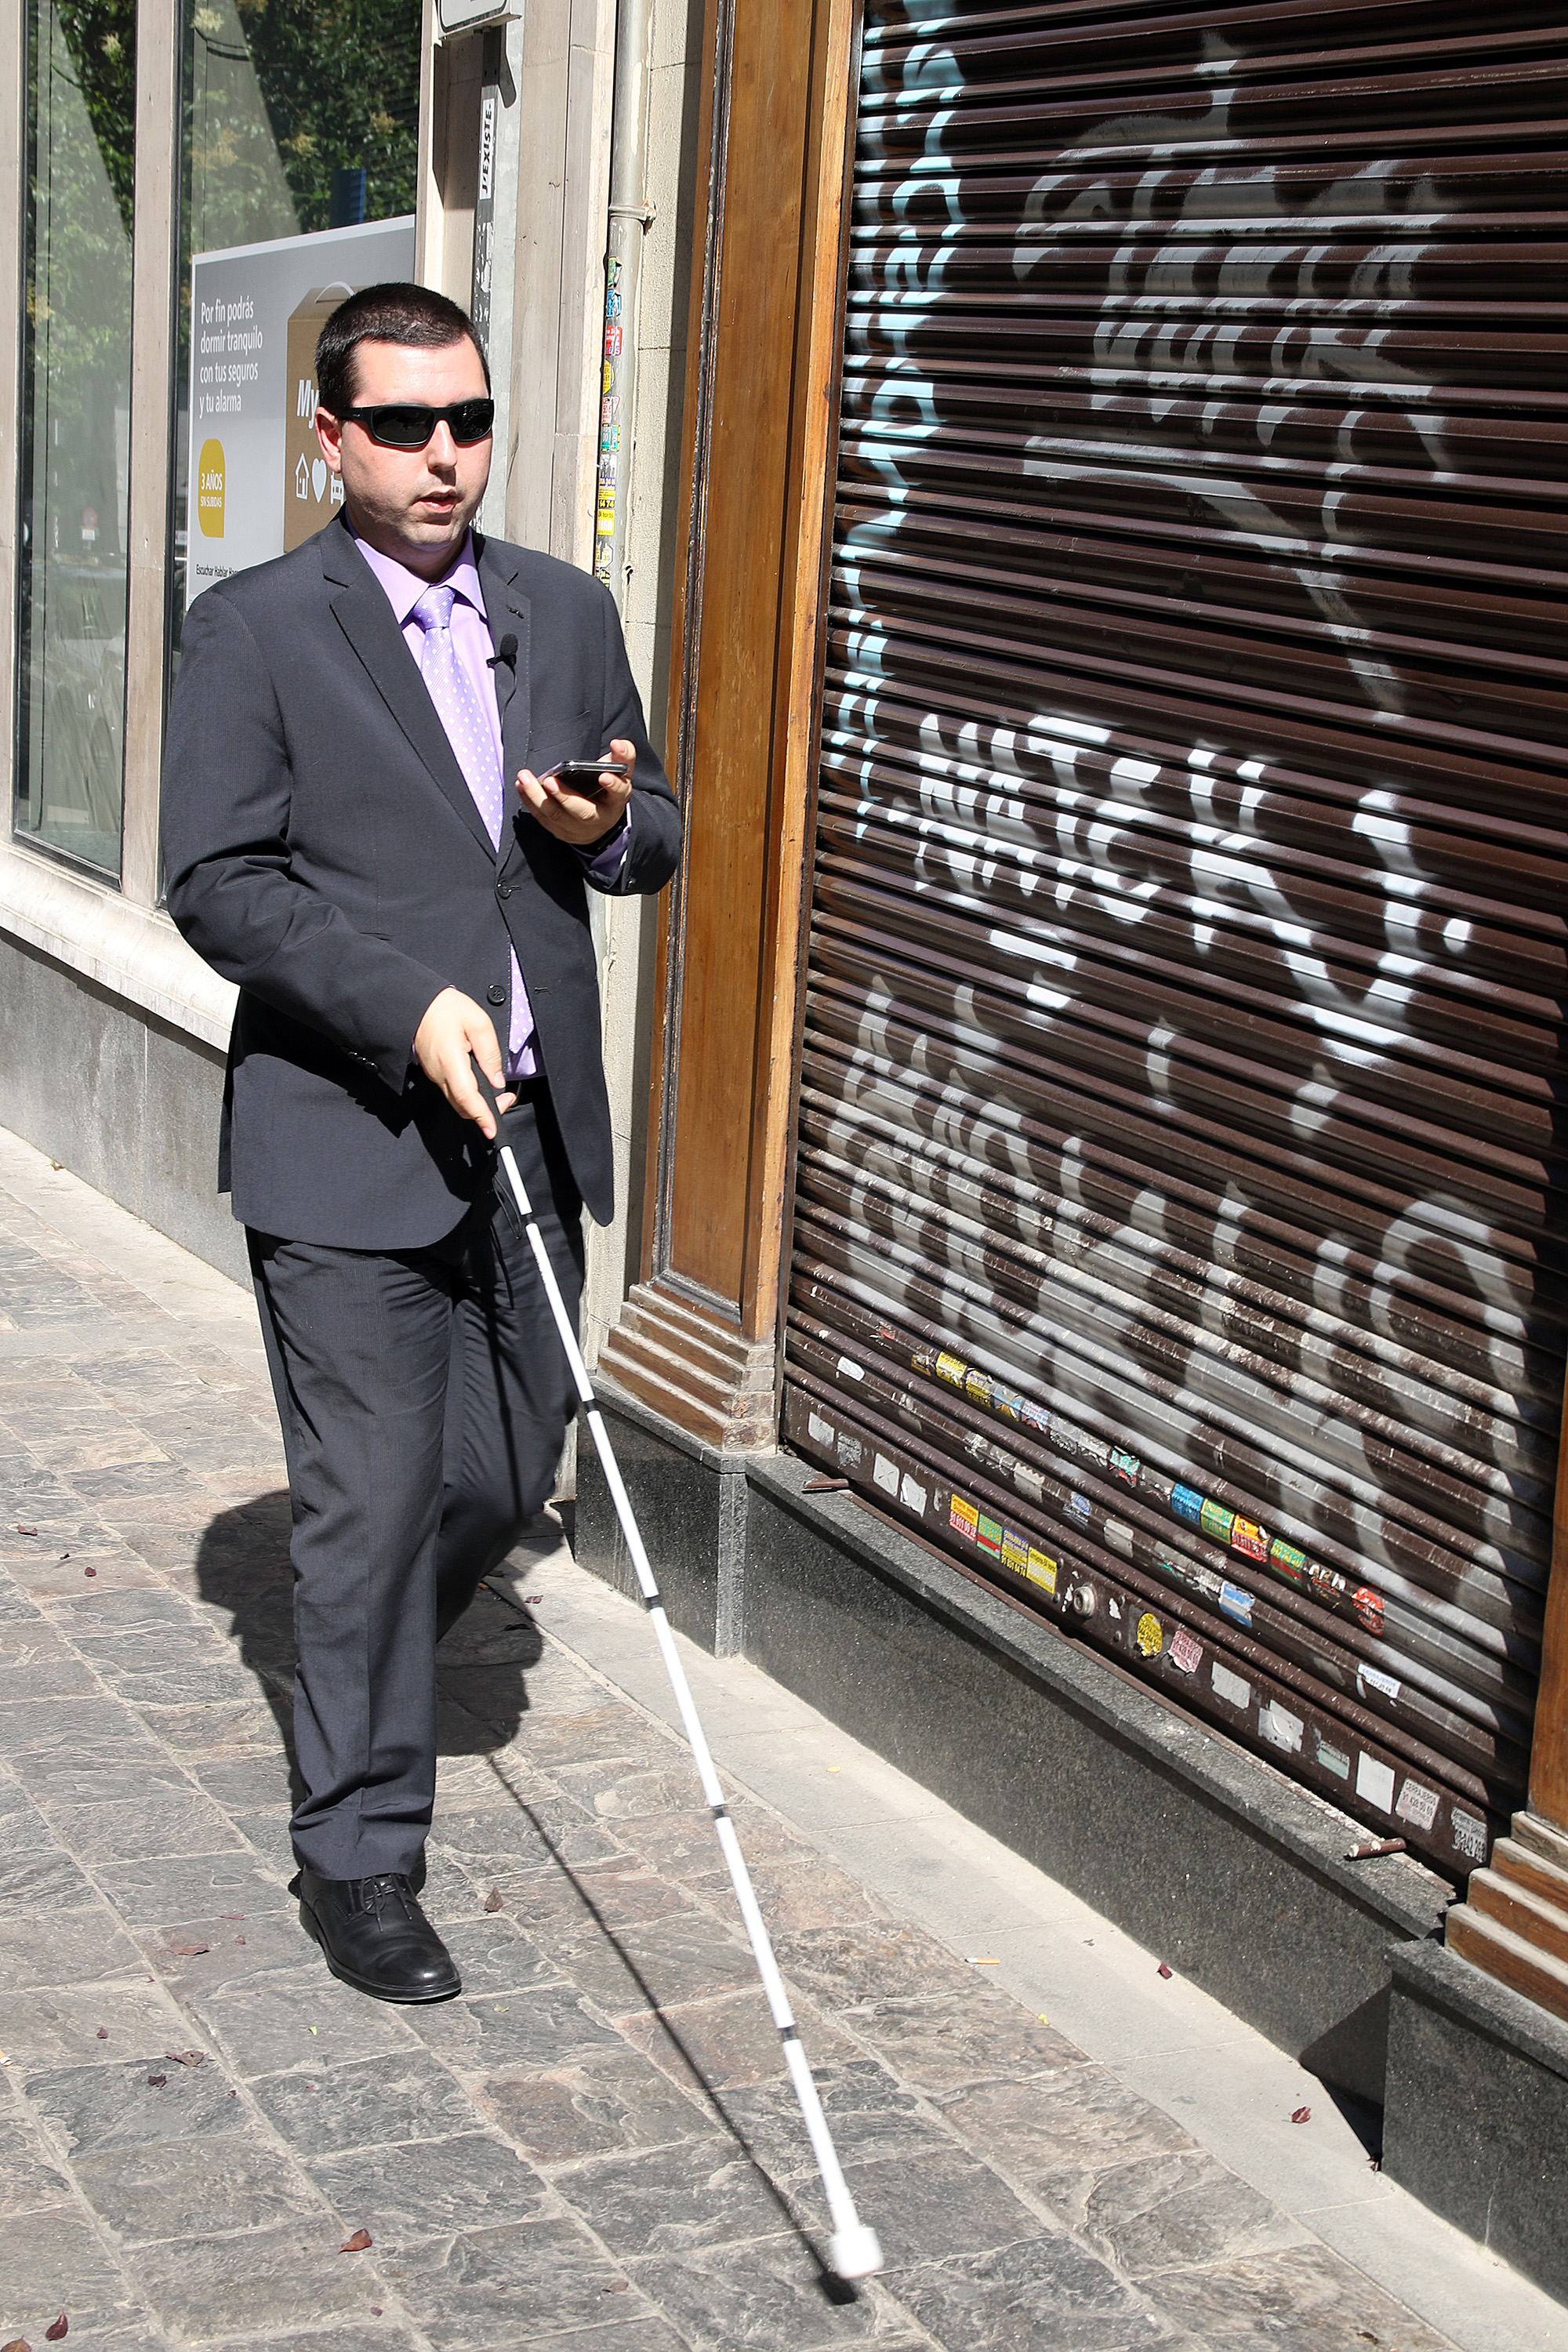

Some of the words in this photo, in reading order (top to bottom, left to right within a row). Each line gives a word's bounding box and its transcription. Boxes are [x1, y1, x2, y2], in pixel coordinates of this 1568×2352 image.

[201, 302, 214, 325] Por
[215, 298, 225, 322] fin
[227, 295, 254, 327] podrás
[200, 329, 227, 354] dormir
[227, 325, 263, 356] tranquilo
[200, 365, 213, 383] con
[215, 361, 227, 383] tus
[228, 362, 259, 387] seguros
[199, 395, 205, 419] y
[205, 392, 214, 413] tu
[215, 389, 242, 412] alarma
[201, 473, 205, 490] 3
[205, 470, 223, 491] AÑOS
[206, 496, 222, 508] SUBIDAS
[196, 564, 214, 576] Escuchar
[214, 565, 228, 577] Hablar
